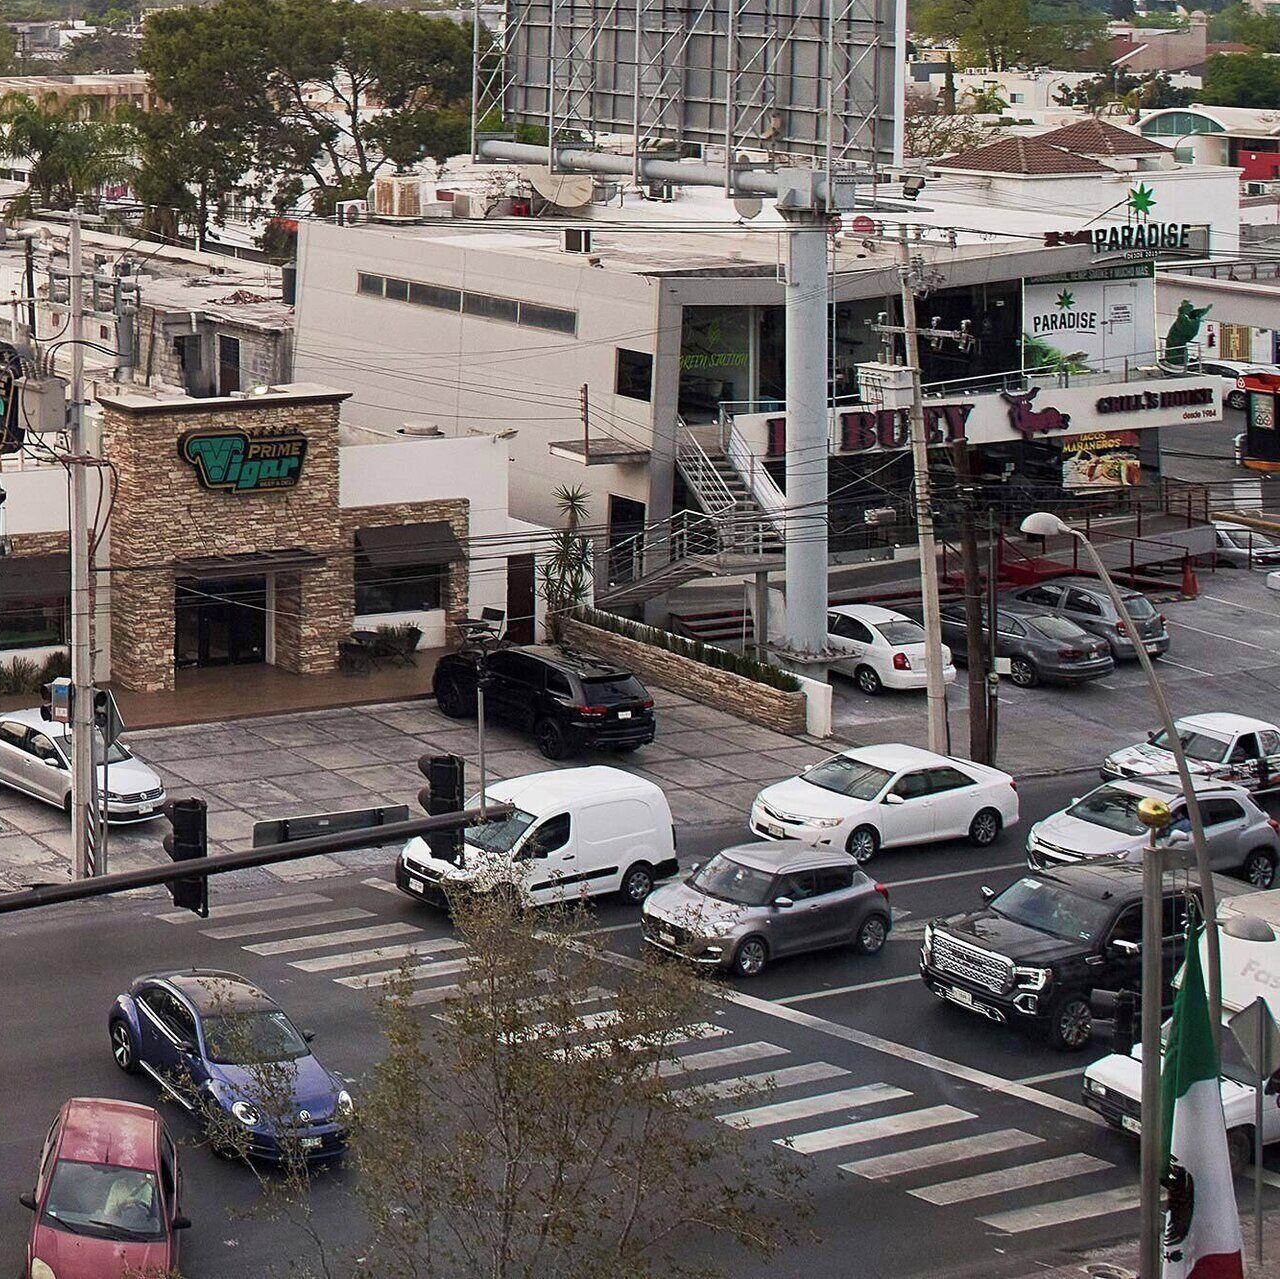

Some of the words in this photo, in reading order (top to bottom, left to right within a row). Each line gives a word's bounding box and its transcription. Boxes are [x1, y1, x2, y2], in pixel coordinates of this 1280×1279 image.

[1095, 223, 1191, 252] PARADISE
[1033, 312, 1097, 332] PARADISE
[1183, 411, 1201, 419] desde
[248, 442, 301, 458] PRIME
[189, 437, 299, 488] Vigar
